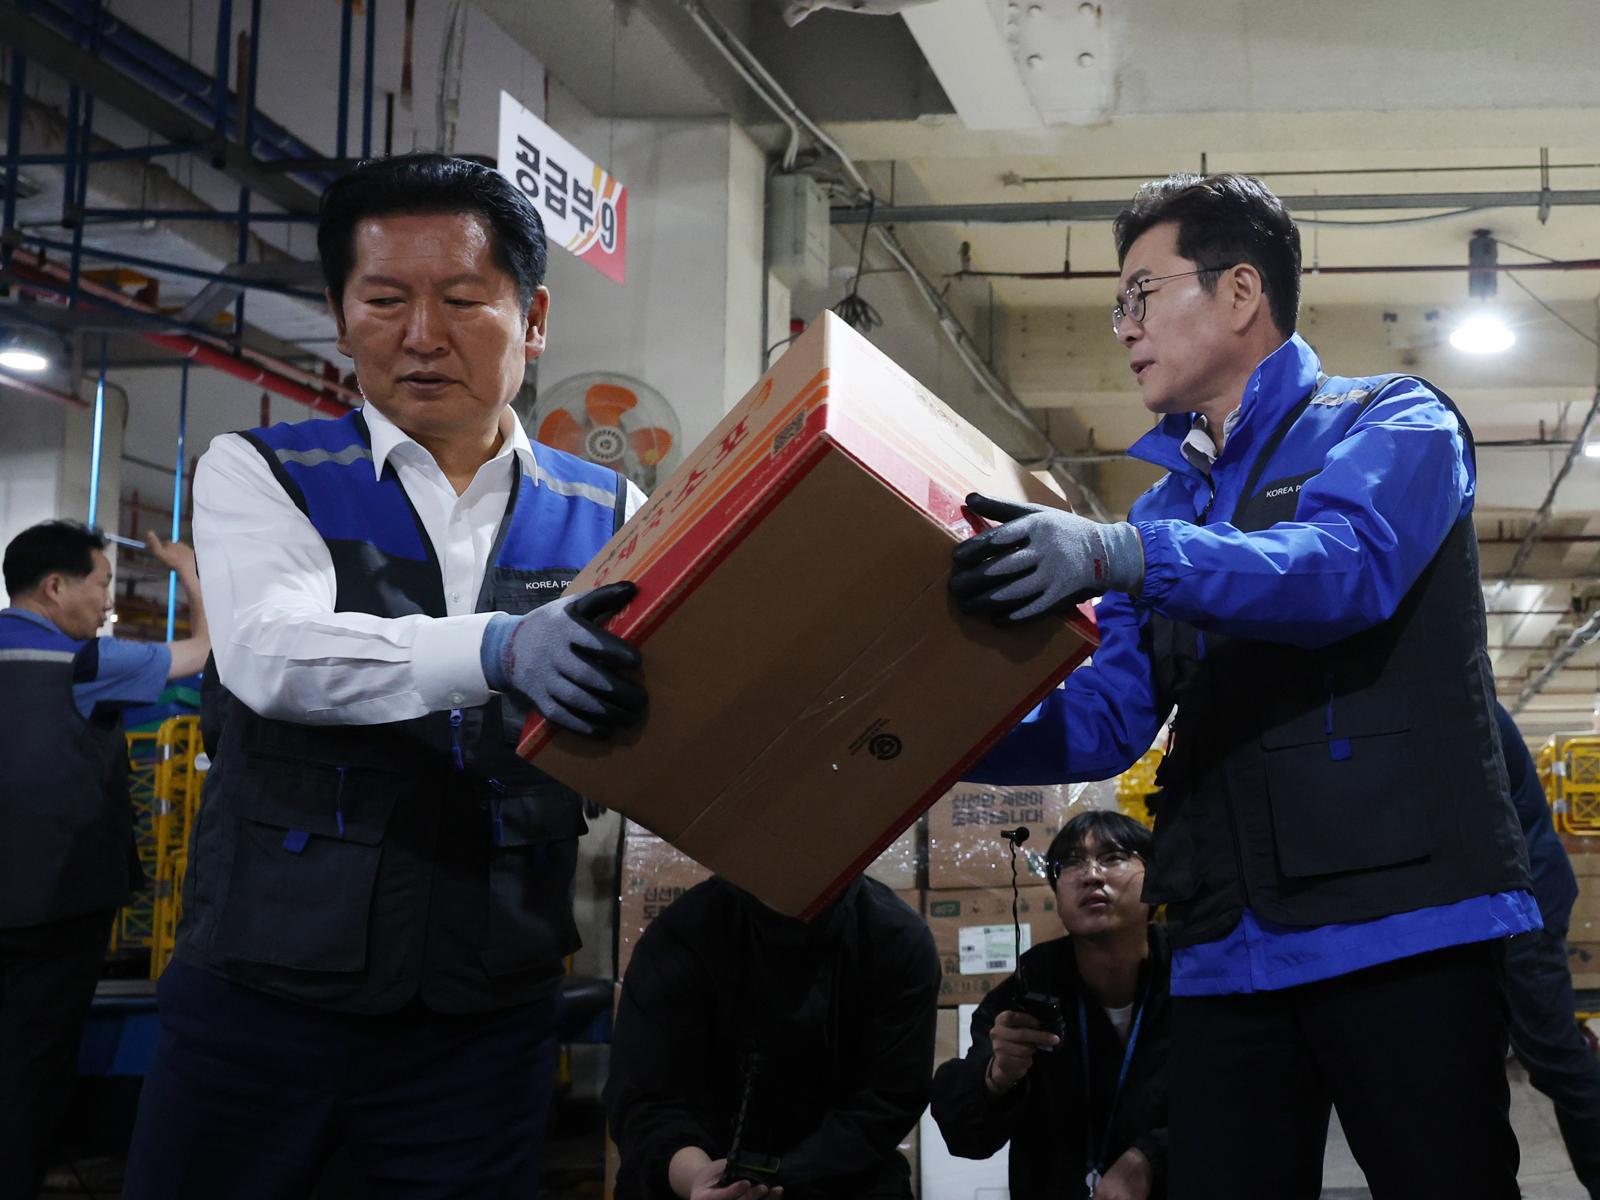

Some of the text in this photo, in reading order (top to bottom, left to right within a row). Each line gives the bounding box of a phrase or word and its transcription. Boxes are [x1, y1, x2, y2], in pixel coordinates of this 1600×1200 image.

[516, 134, 615, 250] 공급부 9
[1266, 486, 1294, 498] KOREA
[526, 580, 559, 590] KOREA
